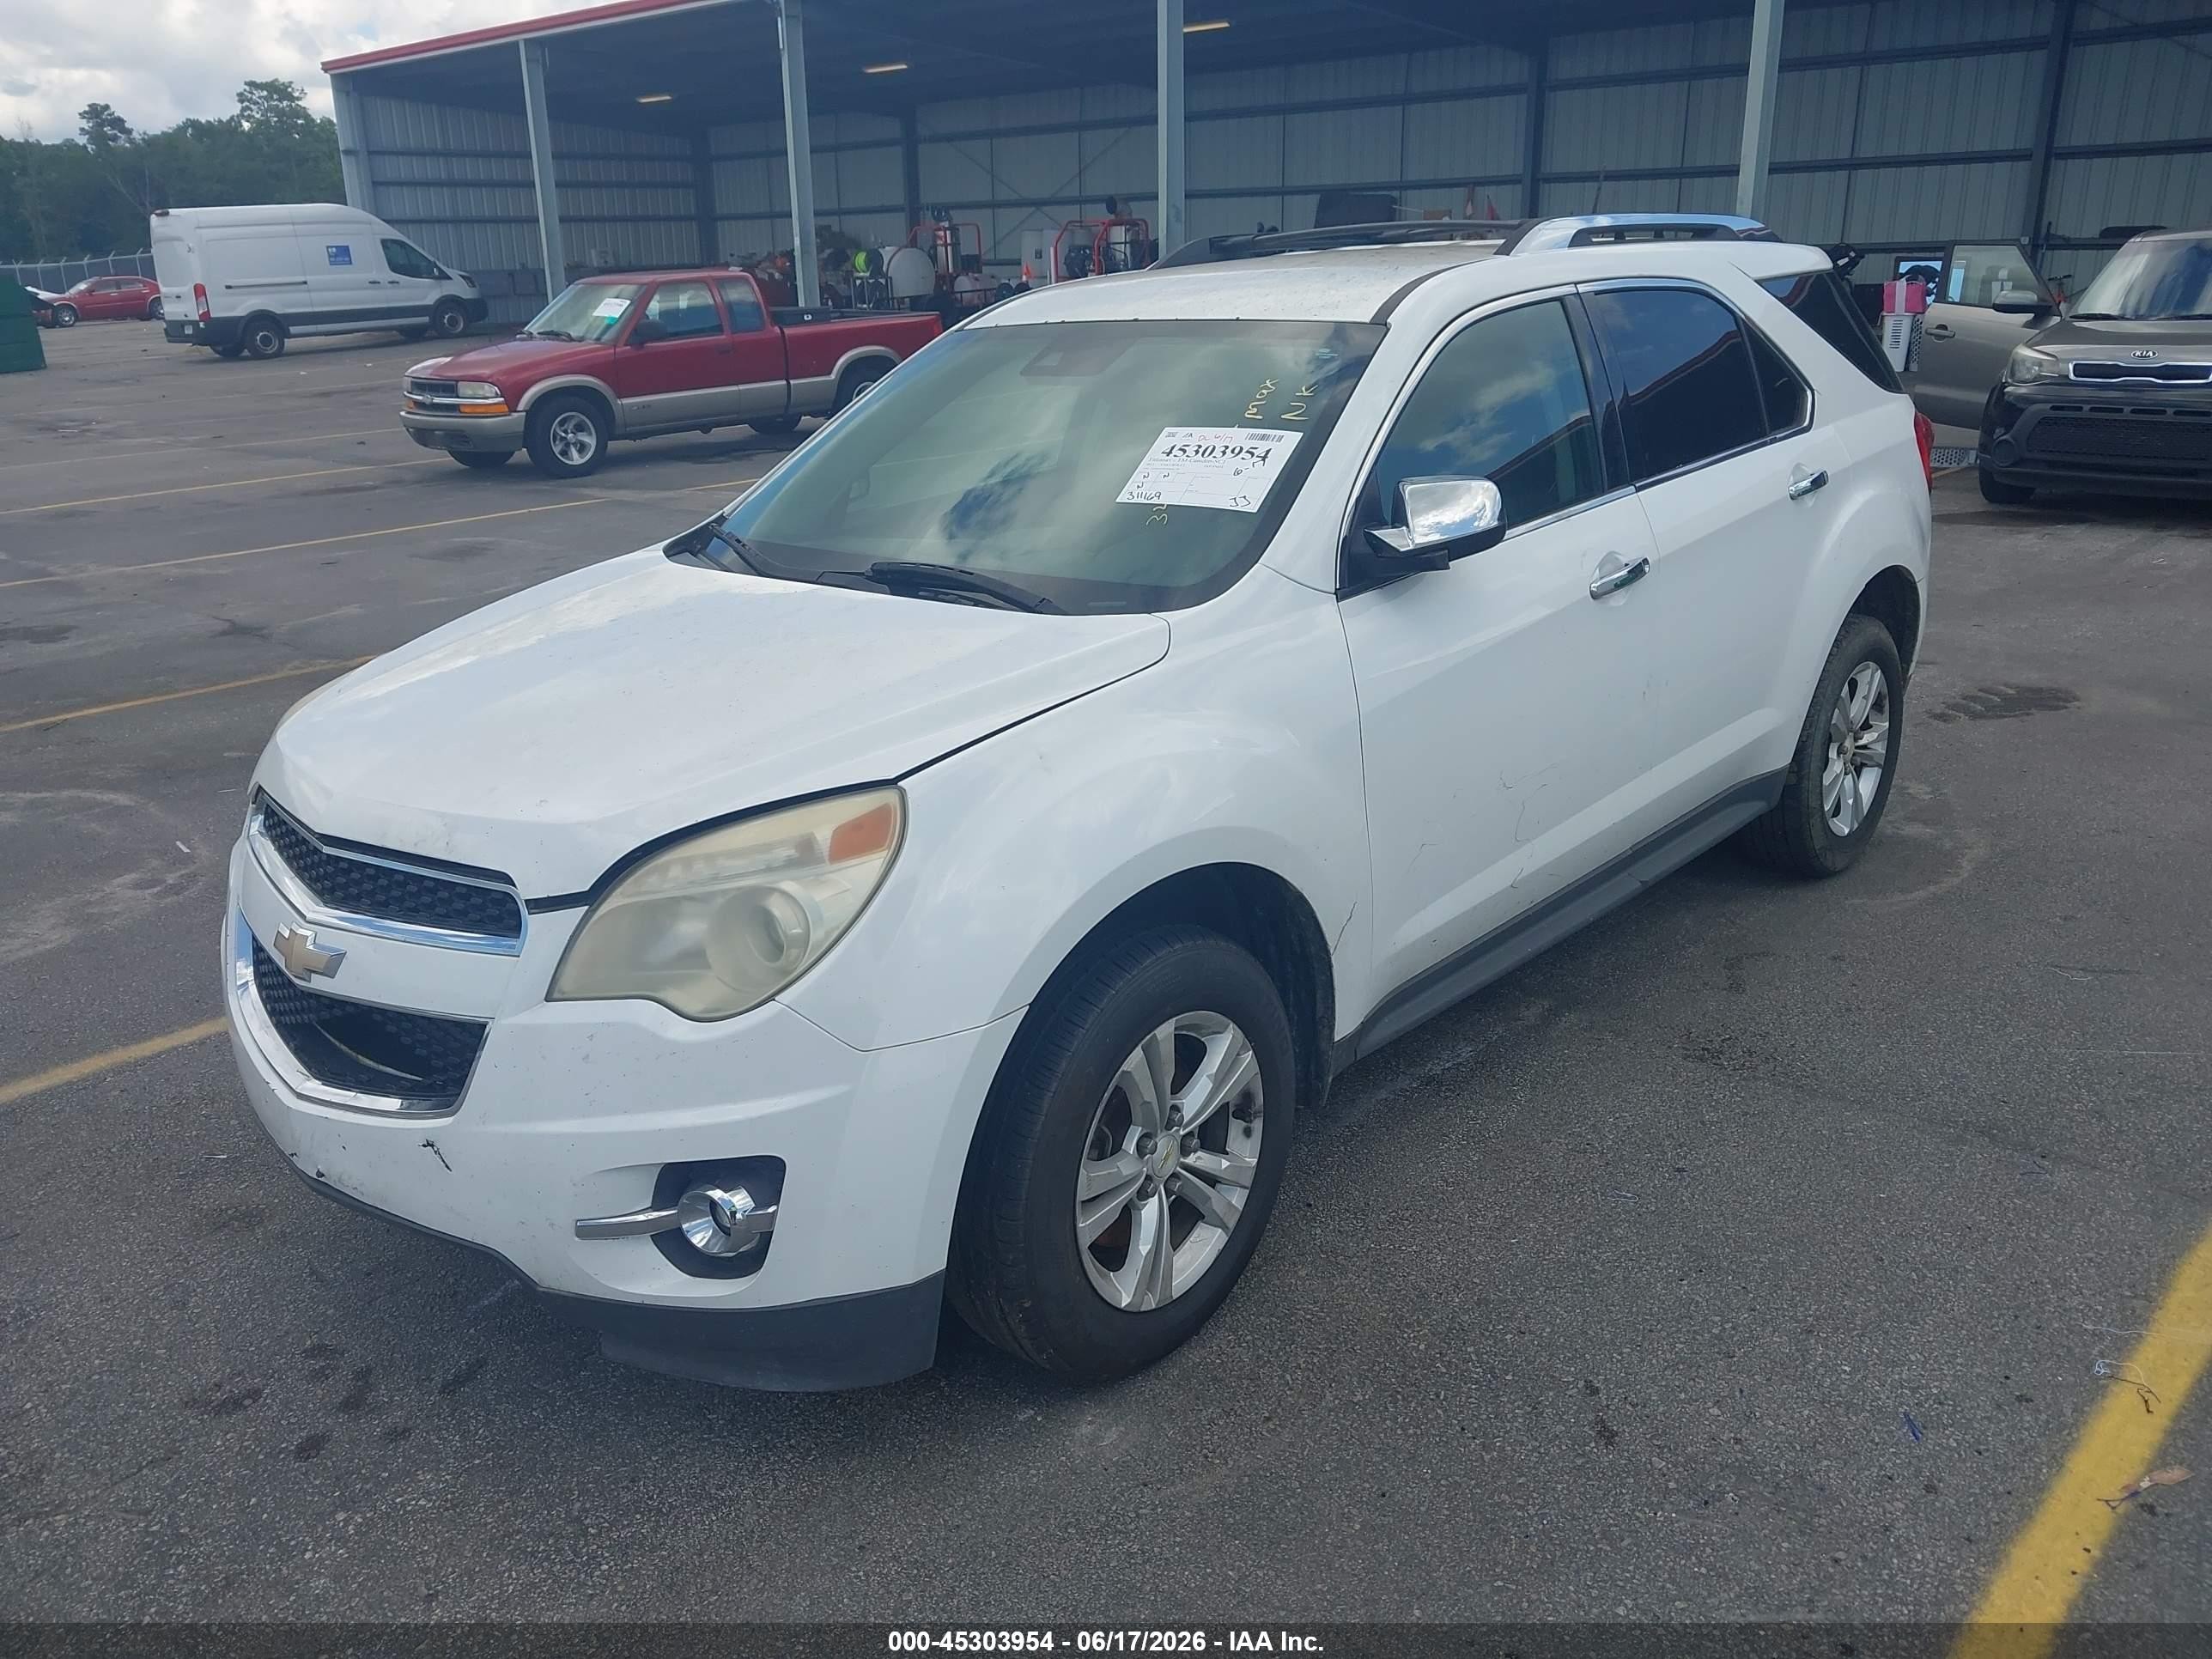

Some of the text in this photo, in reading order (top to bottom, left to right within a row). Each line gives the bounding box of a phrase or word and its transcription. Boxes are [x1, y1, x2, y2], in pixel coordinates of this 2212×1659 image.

[2134, 349, 2154, 358] KIA
[1161, 444, 1272, 460] 45303954
[1126, 491, 1162, 501] 311169
